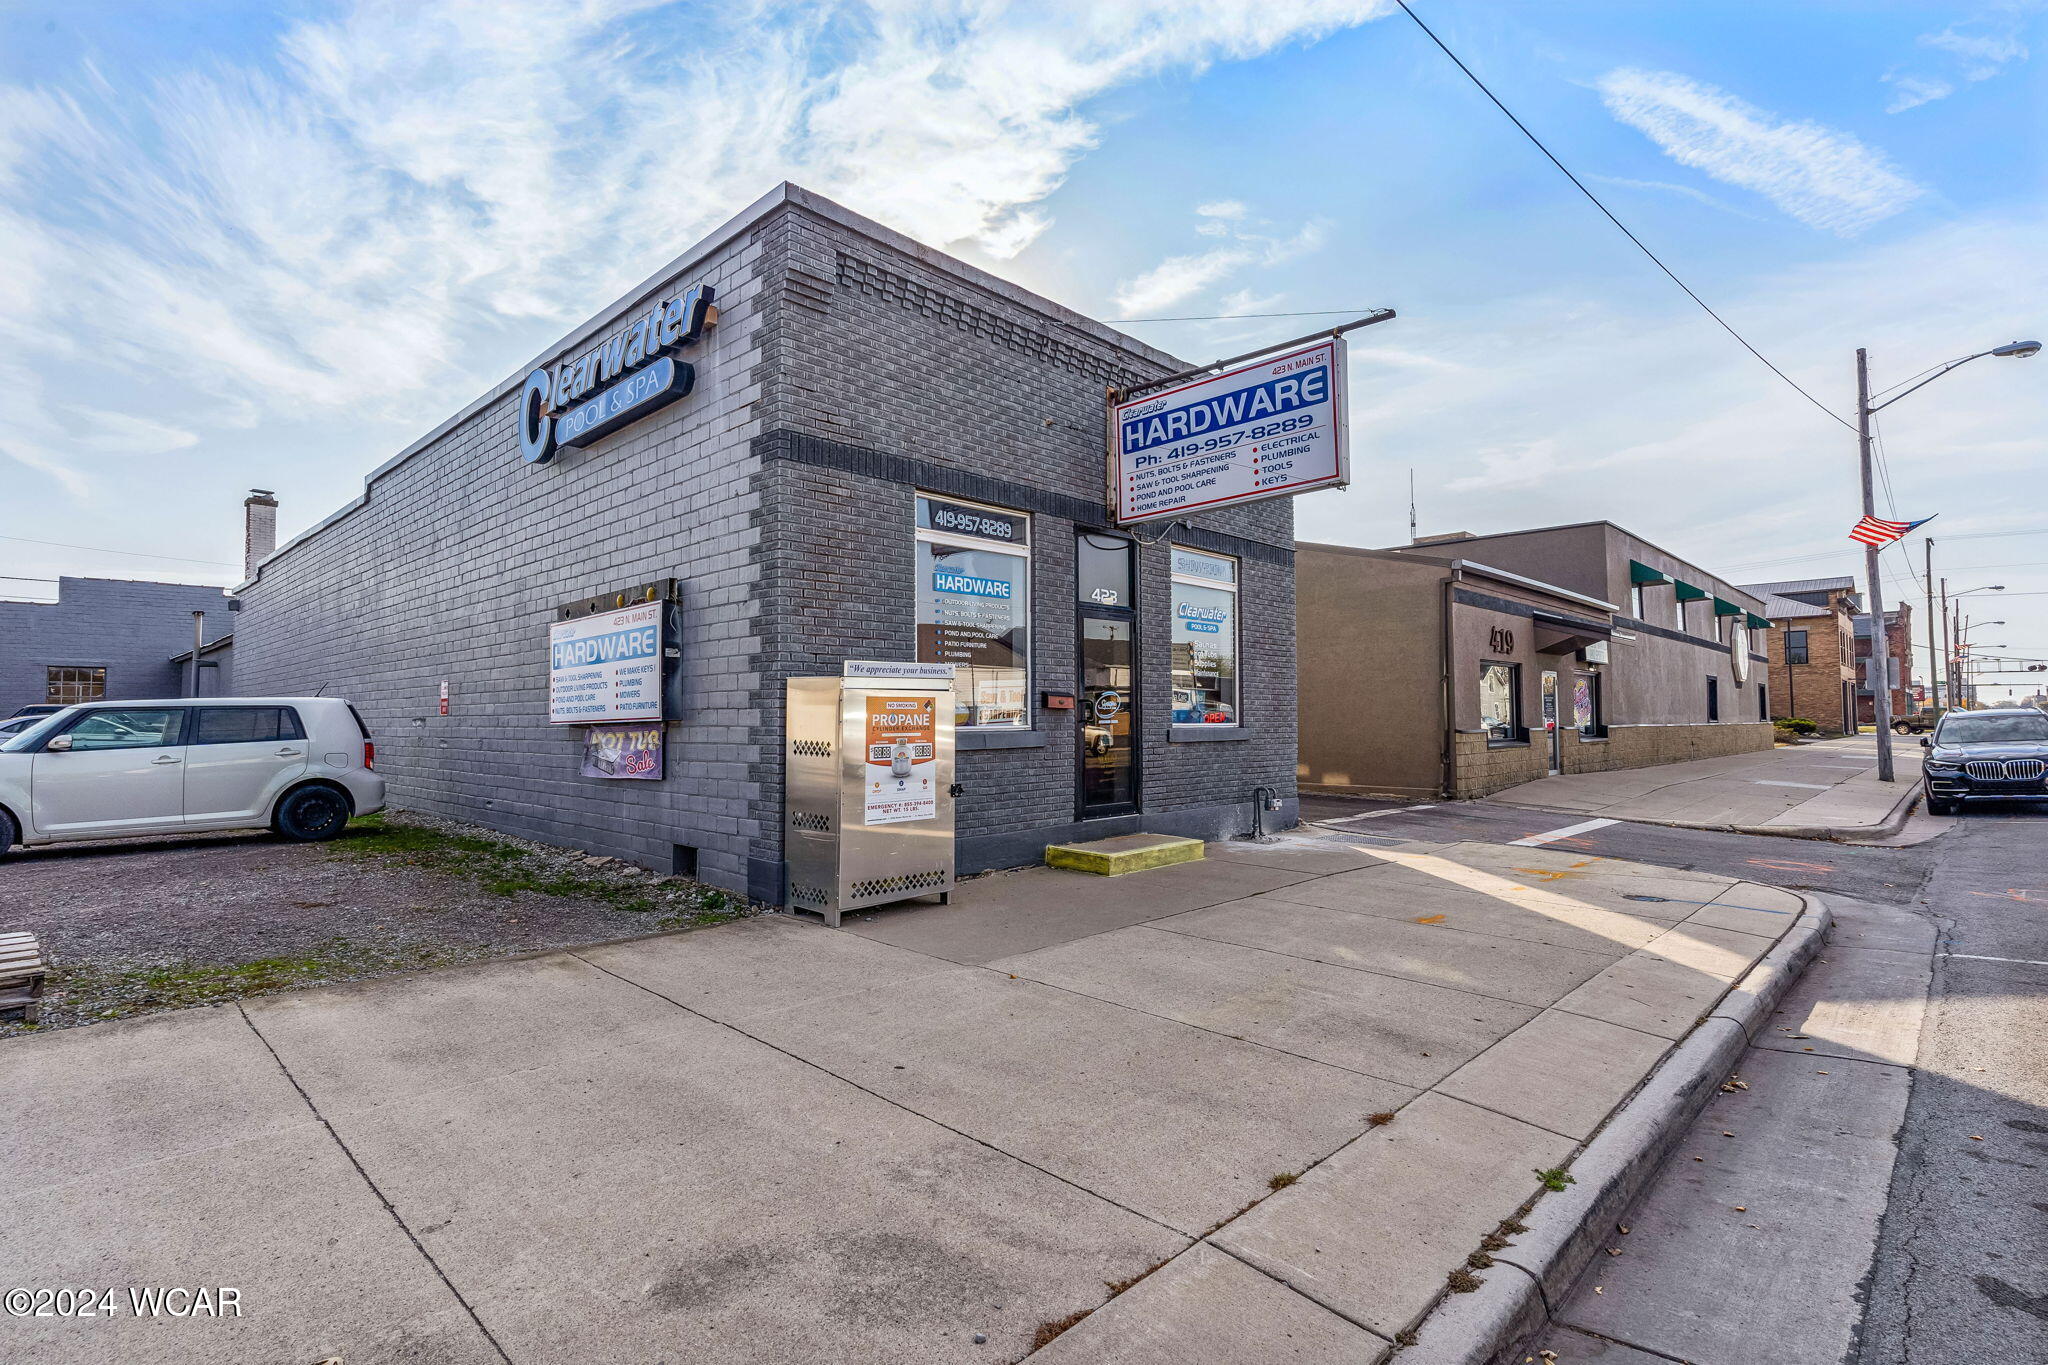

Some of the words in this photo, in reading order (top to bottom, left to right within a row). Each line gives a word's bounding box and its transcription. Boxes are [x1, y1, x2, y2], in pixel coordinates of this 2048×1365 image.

[519, 283, 704, 464] Clearwater
[1272, 366, 1286, 375] 423
[1296, 357, 1314, 369] MAIN
[1316, 353, 1327, 363] ST.
[566, 400, 606, 437] POOL
[611, 391, 622, 411] &
[627, 370, 659, 403] SPA
[1122, 400, 1168, 421] Clearwater
[1126, 370, 1324, 450] HARDWARE
[1135, 454, 1162, 469] Ph:
[1167, 415, 1314, 459] 419-957-8289
[1261, 431, 1320, 451] ELECTRICAL
[1157, 464, 1181, 476] BOLTS
[1189, 450, 1237, 468] FASTENERS
[1261, 444, 1310, 462] PLUMBING
[1136, 481, 1154, 491] SAW
[1161, 476, 1180, 485] TOOL
[1181, 464, 1230, 481] SHARPENING
[1262, 461, 1293, 474] TOOLS
[1136, 491, 1157, 502] POND
[1157, 487, 1173, 496] AND
[1174, 483, 1195, 493] POOL
[1196, 477, 1217, 488] CARE
[1262, 474, 1288, 486] KEYS
[1136, 503, 1158, 512] HOME
[1158, 495, 1186, 505] REPAIR
[934, 510, 1012, 538] 419-957-8289
[936, 574, 1010, 597] HARDWARE
[1091, 588, 1118, 603] 423
[631, 611, 647, 622] MAIN
[1179, 602, 1228, 622] Clearwater
[554, 629, 654, 667] HARDWARE
[1489, 626, 1515, 655] 419
[619, 667, 627, 676] WE
[628, 665, 640, 674] MAKE
[866, 666, 901, 675] appreciate
[586, 681, 608, 691] PRODUCTS
[619, 690, 641, 699] MOWERS
[585, 693, 596, 701] CARE
[619, 702, 632, 711] PATIO
[632, 700, 658, 710] FURNITURE
[582, 704, 607, 713] FASTENERS
[1204, 711, 1227, 724] OPEN
[872, 713, 930, 726] PROPANE
[626, 750, 656, 775] Sale
